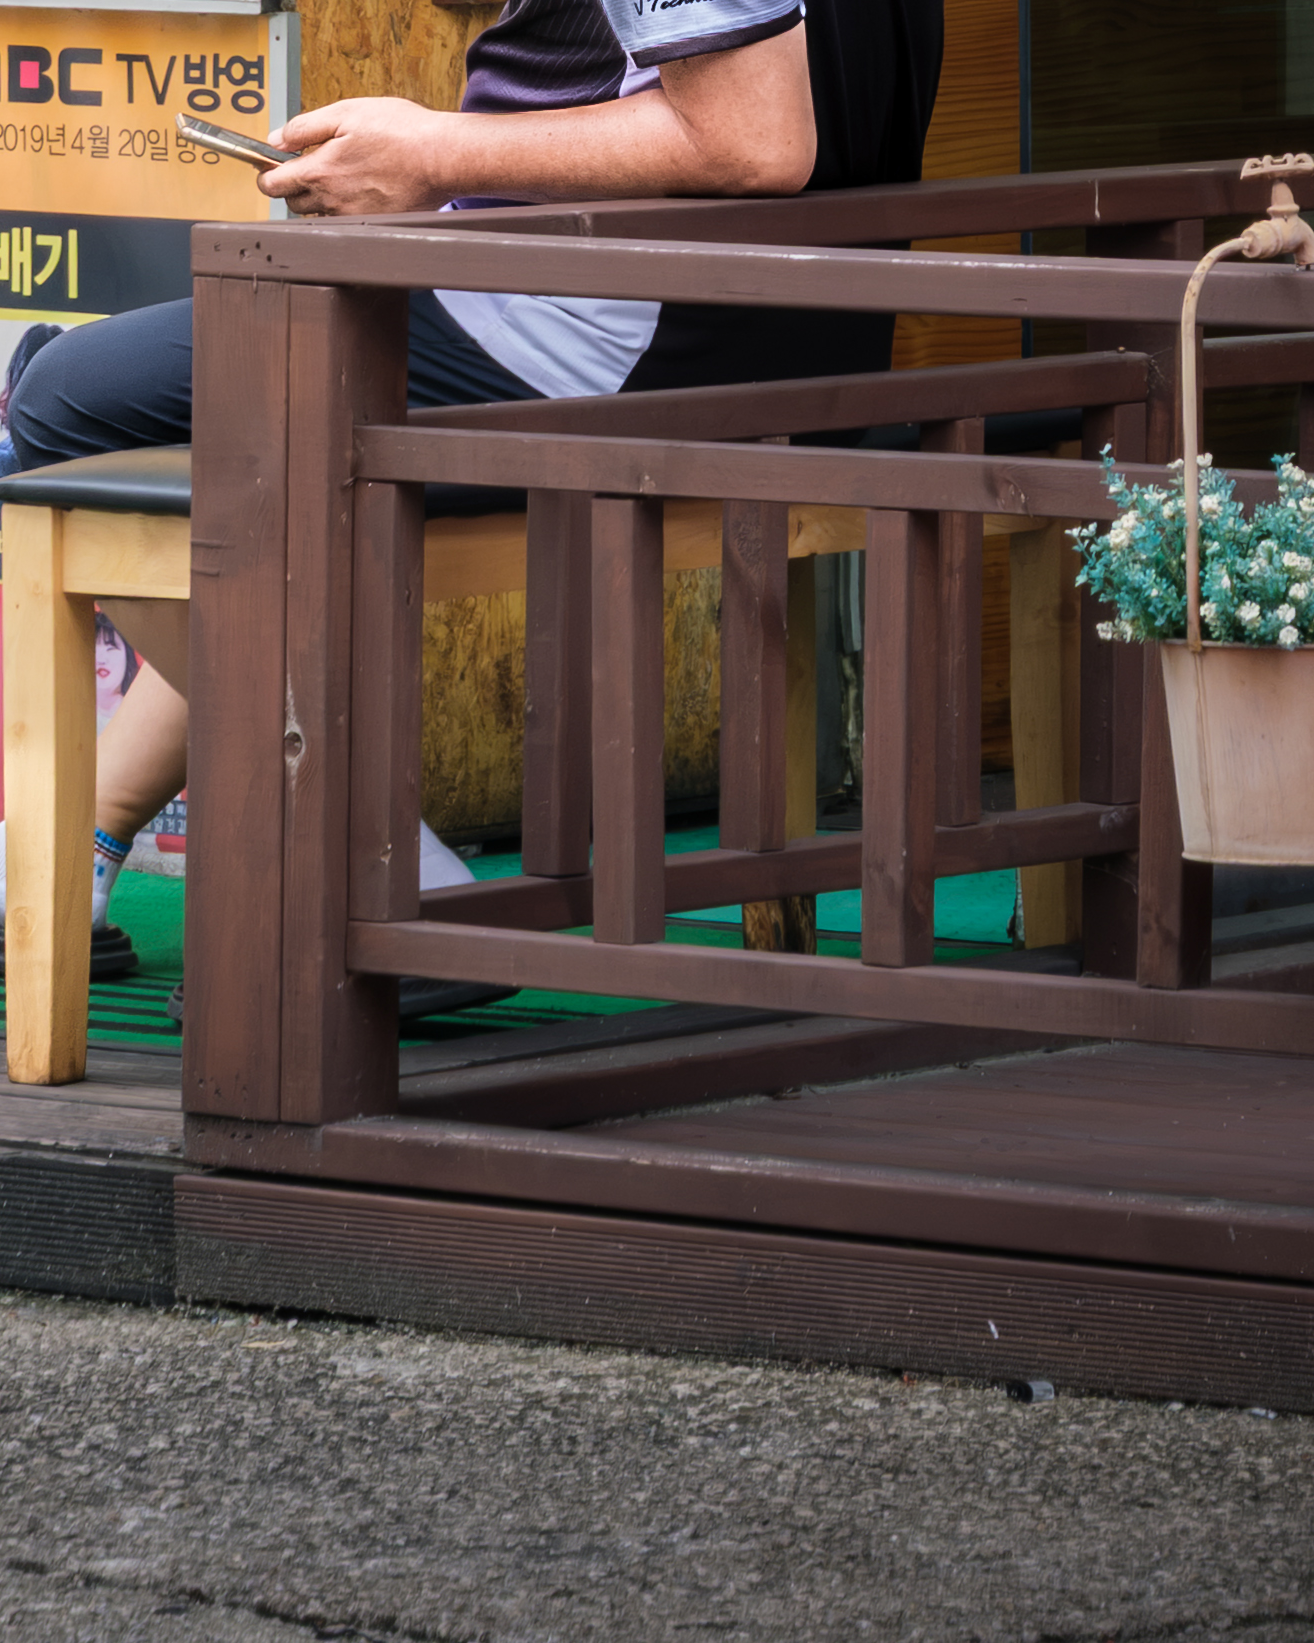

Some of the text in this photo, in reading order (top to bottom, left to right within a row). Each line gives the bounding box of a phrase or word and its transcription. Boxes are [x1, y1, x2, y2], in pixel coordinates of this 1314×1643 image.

[115, 52, 177, 106] TV
[182, 52, 265, 115] 방영
[70, 124, 110, 159] 4월
[117, 127, 170, 164] 20일
